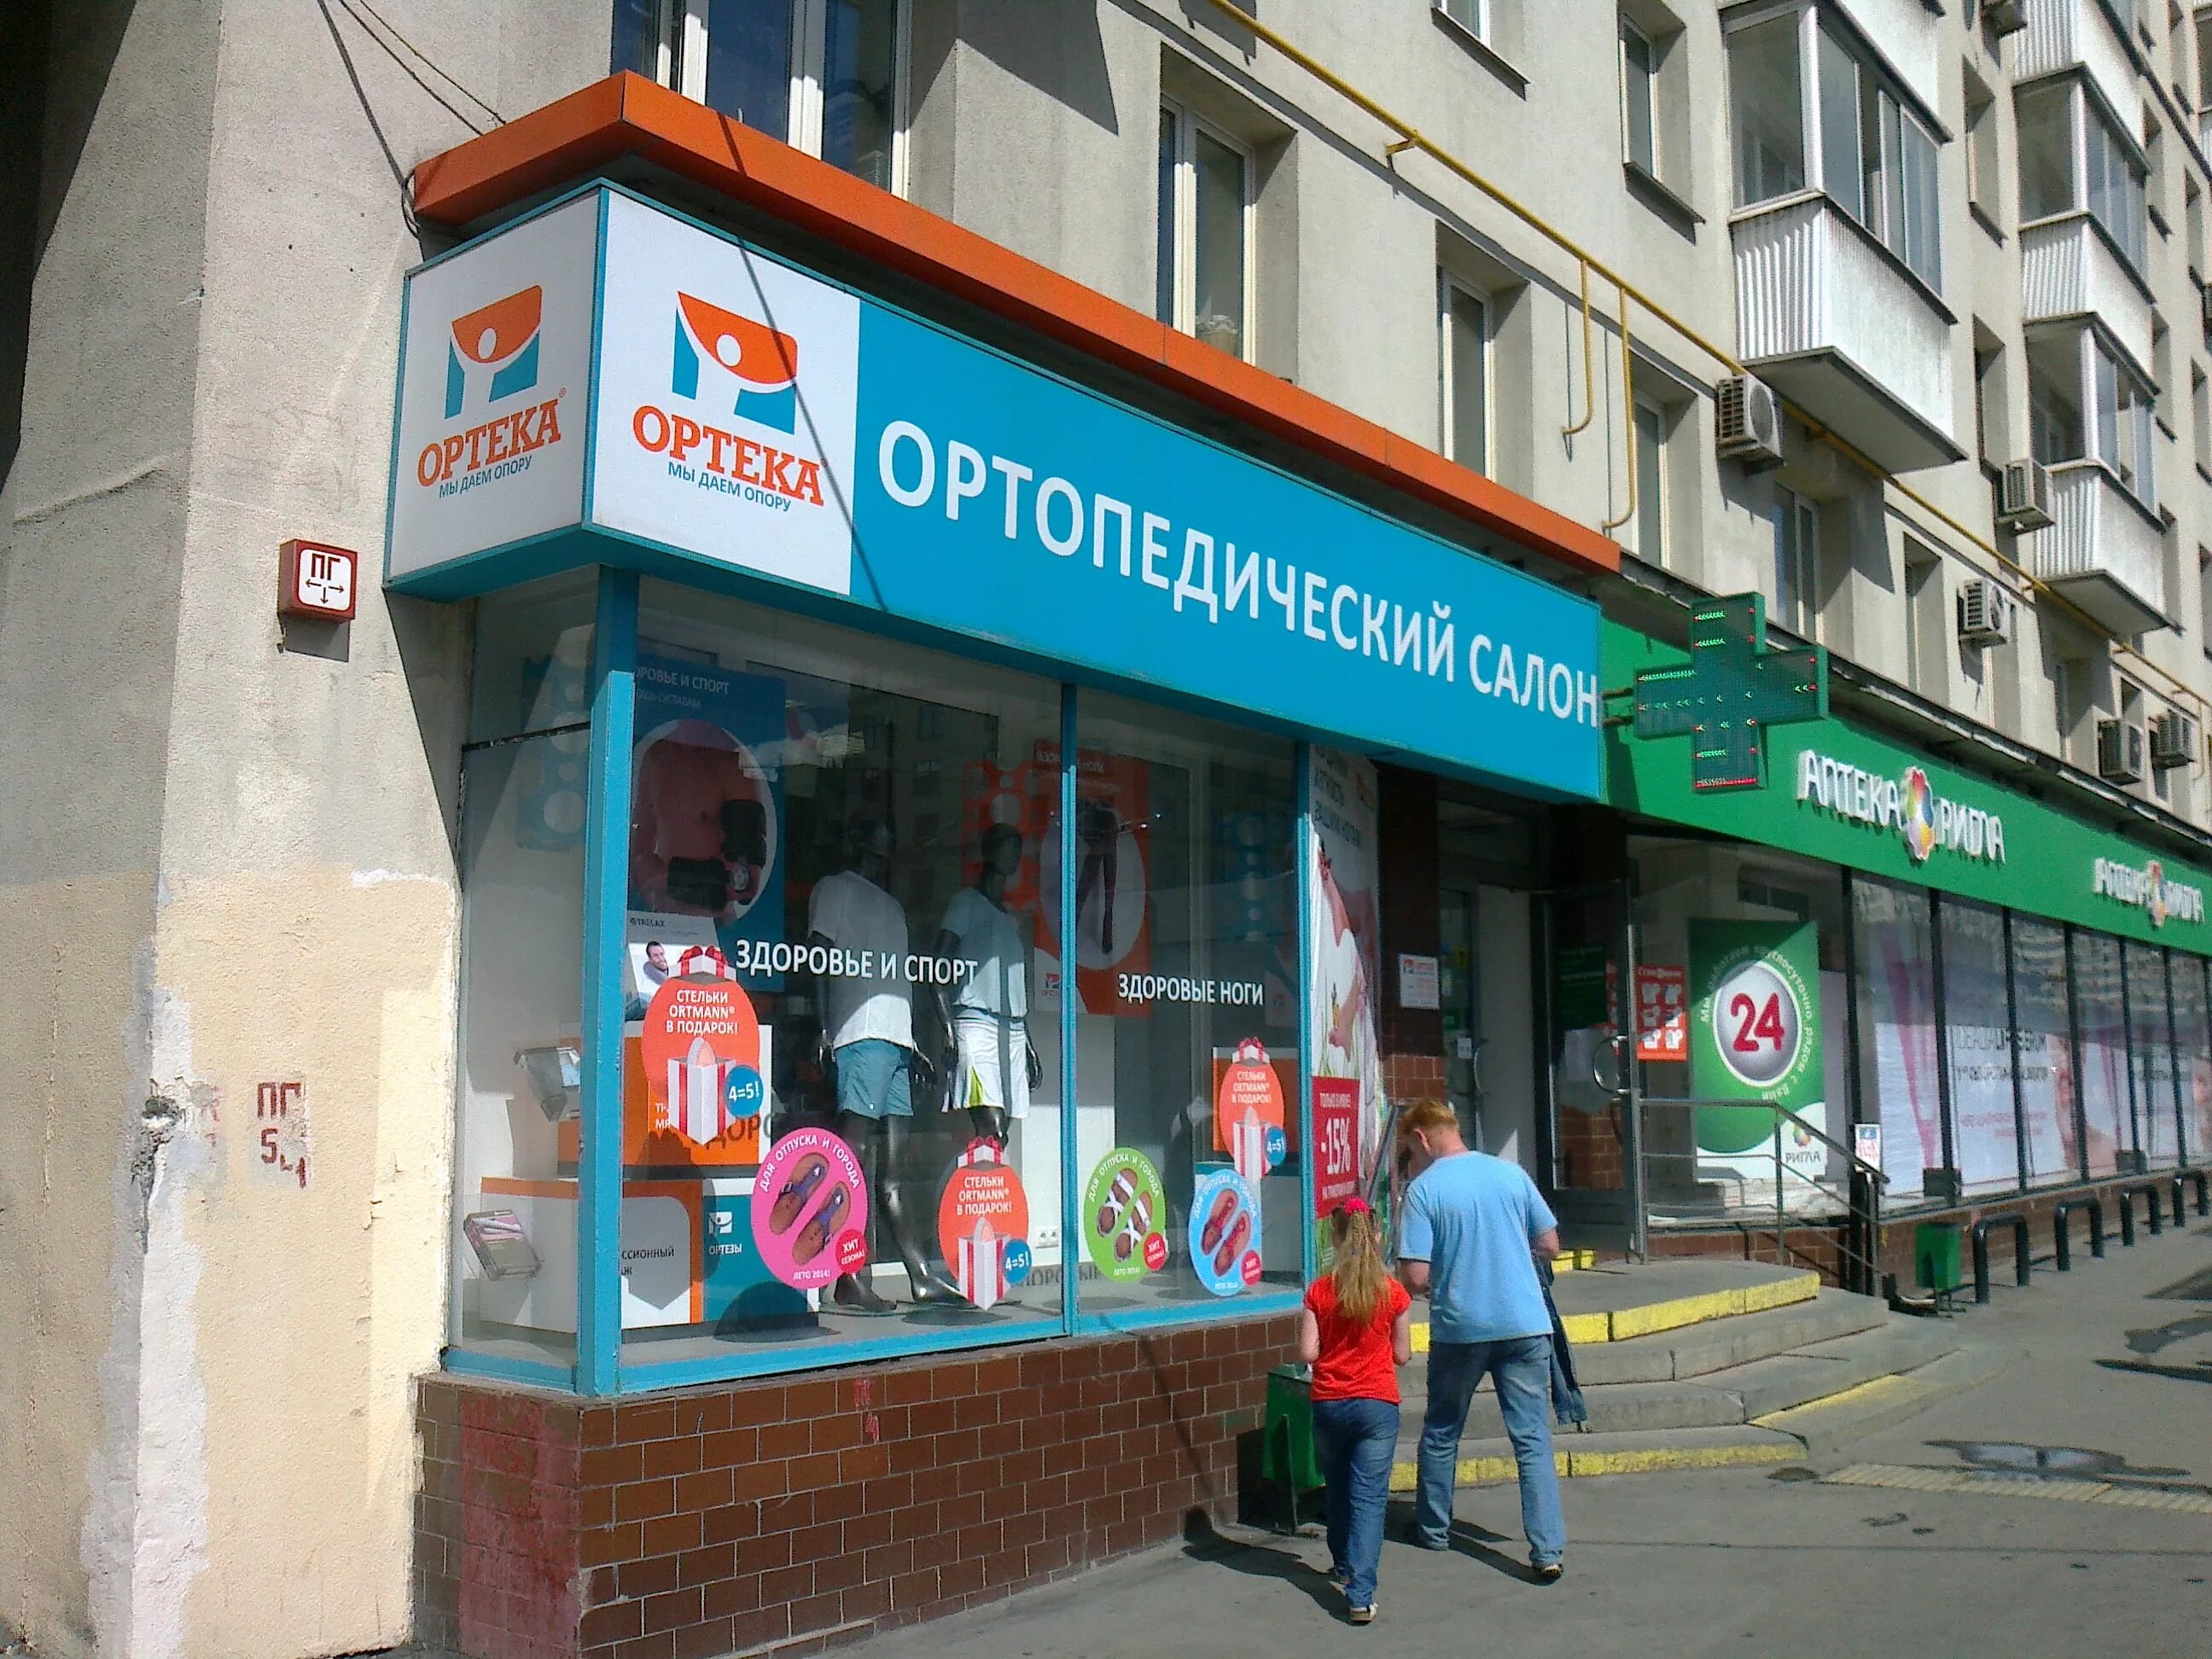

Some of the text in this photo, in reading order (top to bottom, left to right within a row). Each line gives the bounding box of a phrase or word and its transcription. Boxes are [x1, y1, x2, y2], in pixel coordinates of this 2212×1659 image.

[632, 405, 824, 506] ОРТЕКА
[439, 456, 533, 498] МЫ ДАЕМ ОПОРУ
[668, 462, 791, 513] МЫ ДАЕМ ОПОРУ
[311, 553, 341, 581] ПГ
[878, 420, 1598, 728] ОРТОПЕДИЧЕСКИЙ САЛОН
[1796, 749, 1904, 831] АПТЕКА
[736, 939, 979, 986] ЗДОРОВЬЕ И СПОРТ
[676, 989, 729, 1003] СТЕЛЬКИ
[1118, 972, 1264, 1006] ЗДОРОВЫЕ НОГИ
[666, 1020, 738, 1037] В ПОДАРОК!
[1730, 992, 1785, 1051] 24
[258, 1084, 301, 1119] ПГ
[728, 1080, 760, 1103] 4=5!
[759, 1134, 862, 1192] ДЛЯ ОТПУСКА И ГОРОДА
[1320, 1116, 1351, 1175] -15%
[963, 1175, 1004, 1188] СТЕЛЬКИ
[1088, 1179, 1100, 1202] ДЛЯ
[1099, 1153, 1129, 1176] ОТПУСКА
[1138, 1161, 1160, 1198] ГОРОДА
[957, 1202, 1012, 1217] В ПОДАРОК!
[621, 1245, 675, 1260] ССИОННЫЙ
[842, 1238, 859, 1253] ХИТ
[1004, 1250, 1029, 1272] 4=5!
